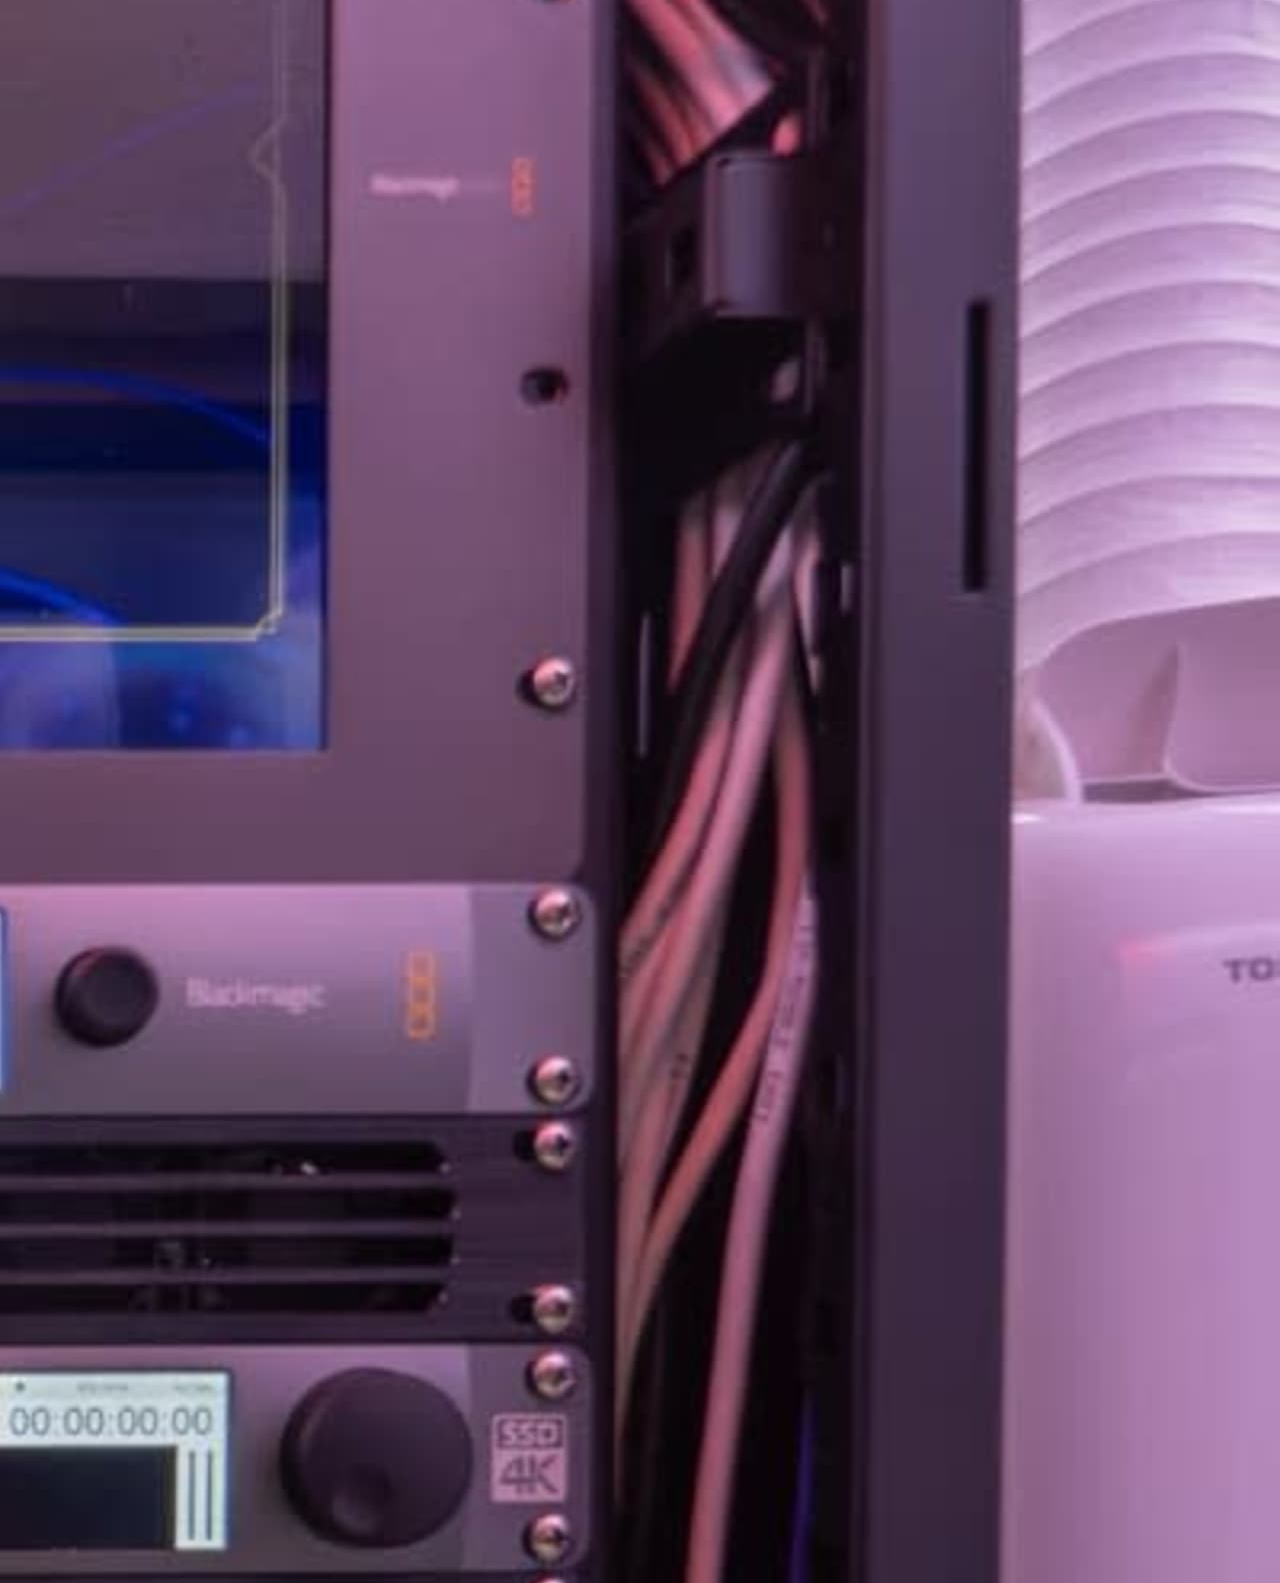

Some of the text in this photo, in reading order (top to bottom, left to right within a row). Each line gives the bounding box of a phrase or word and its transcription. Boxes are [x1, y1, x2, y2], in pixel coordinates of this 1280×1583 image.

[1221, 957, 1280, 984] TO
[186, 977, 326, 1014] Blackmagic
[8, 1405, 214, 1437] 00:00:00:00
[498, 1421, 559, 1447] SSD
[499, 1452, 559, 1495] 4K
